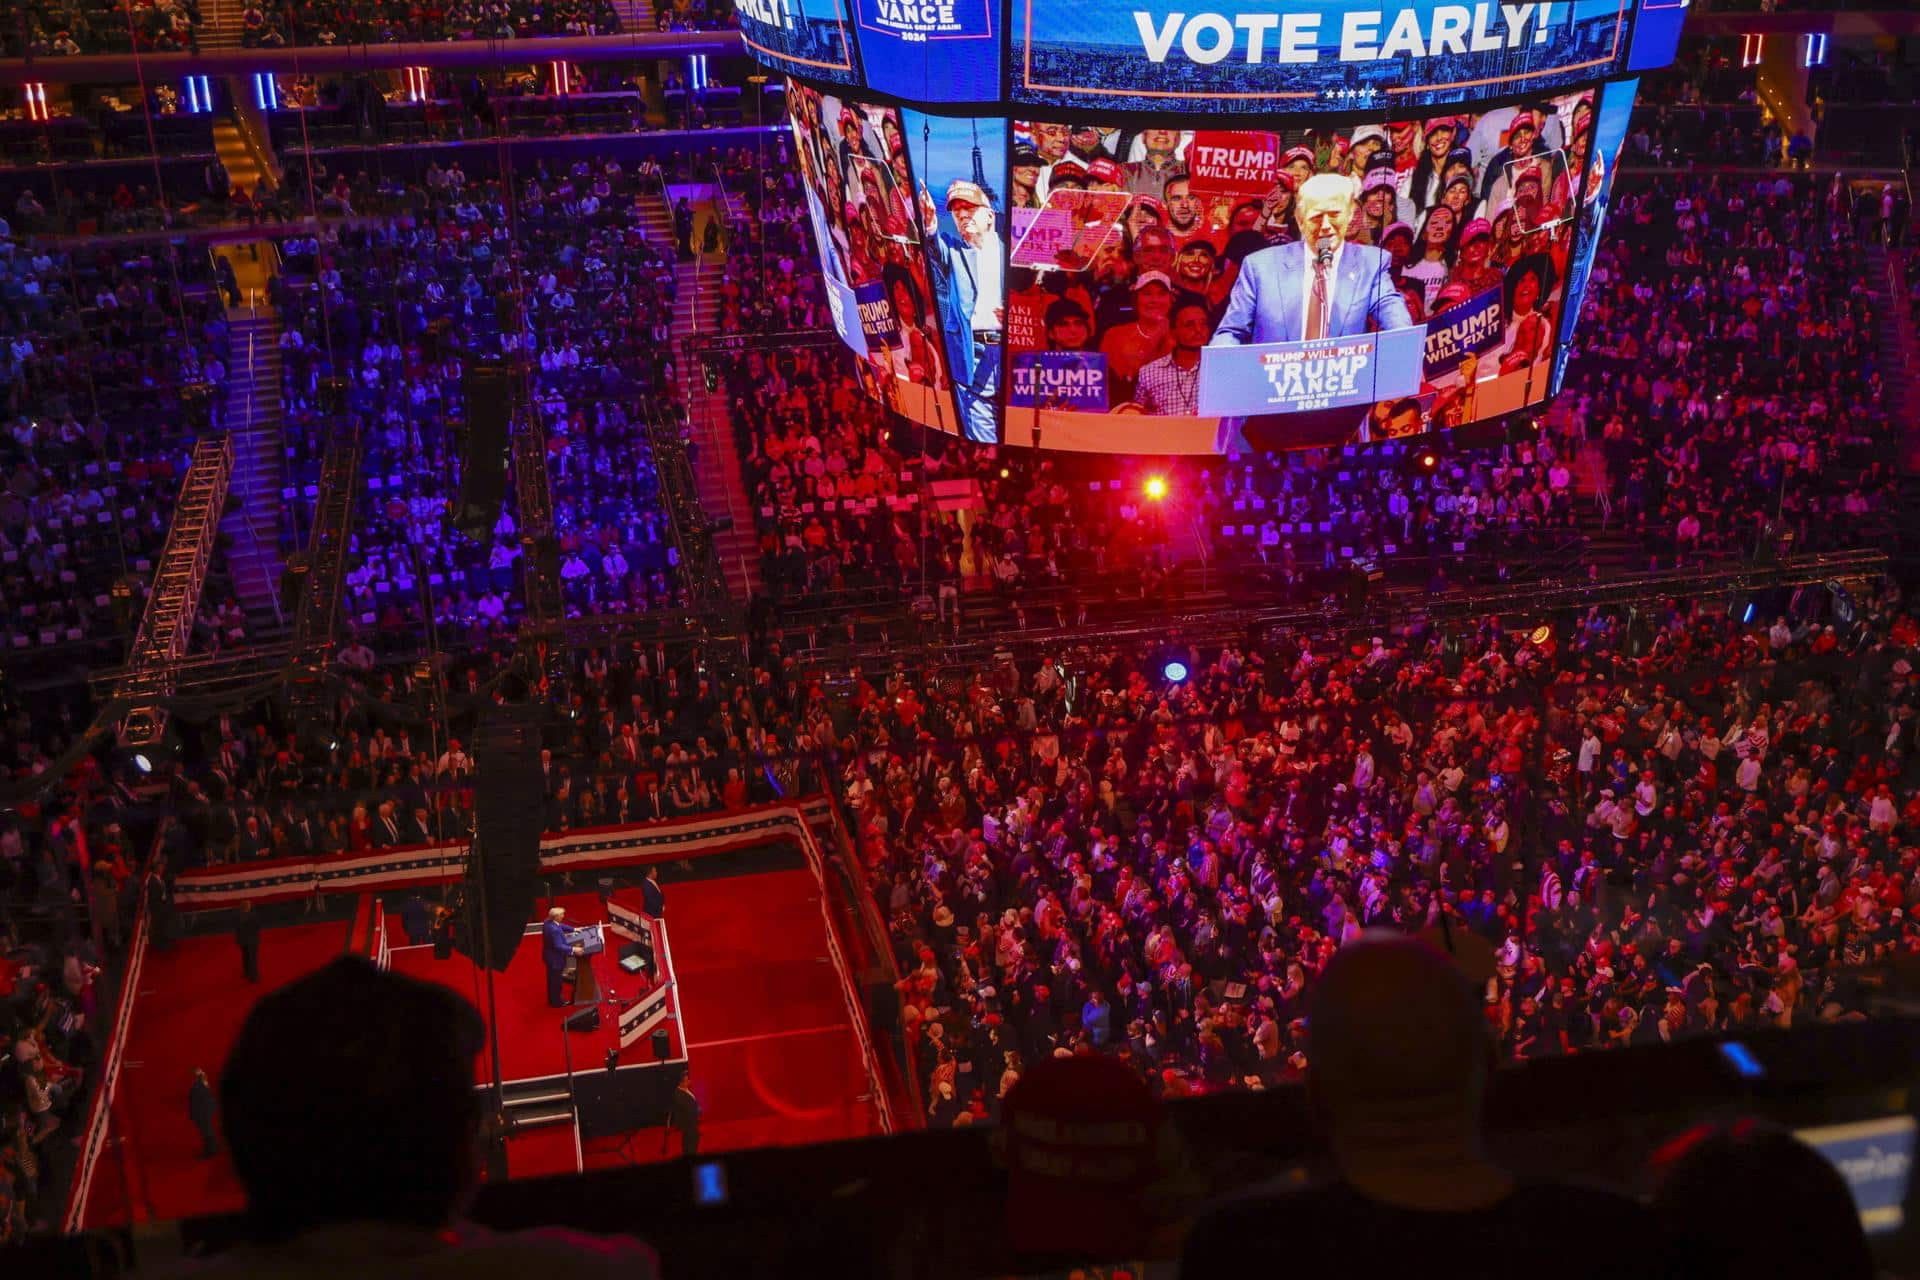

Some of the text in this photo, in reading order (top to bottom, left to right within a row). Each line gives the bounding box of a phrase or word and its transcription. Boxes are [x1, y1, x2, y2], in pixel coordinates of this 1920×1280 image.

[877, 1, 954, 24] VANCE
[901, 31, 926, 42] 2024
[1133, 2, 1552, 63] VOTE EARLY!
[1197, 146, 1275, 169] TRUMP
[1196, 165, 1274, 181] WILL FIX IT
[857, 299, 890, 323] TRUMP
[1426, 303, 1500, 353] TRUMP
[1426, 319, 1499, 364] WILL FIX IT
[1264, 343, 1369, 364] TRUMP WILL FIX IT
[1013, 368, 1103, 386] TRUMP
[1264, 355, 1367, 383] TRUMP
[1058, 386, 1082, 397] FIX
[1087, 386, 1103, 397] IT
[1275, 374, 1355, 397] VANCE
[1297, 399, 1329, 411] 2024
